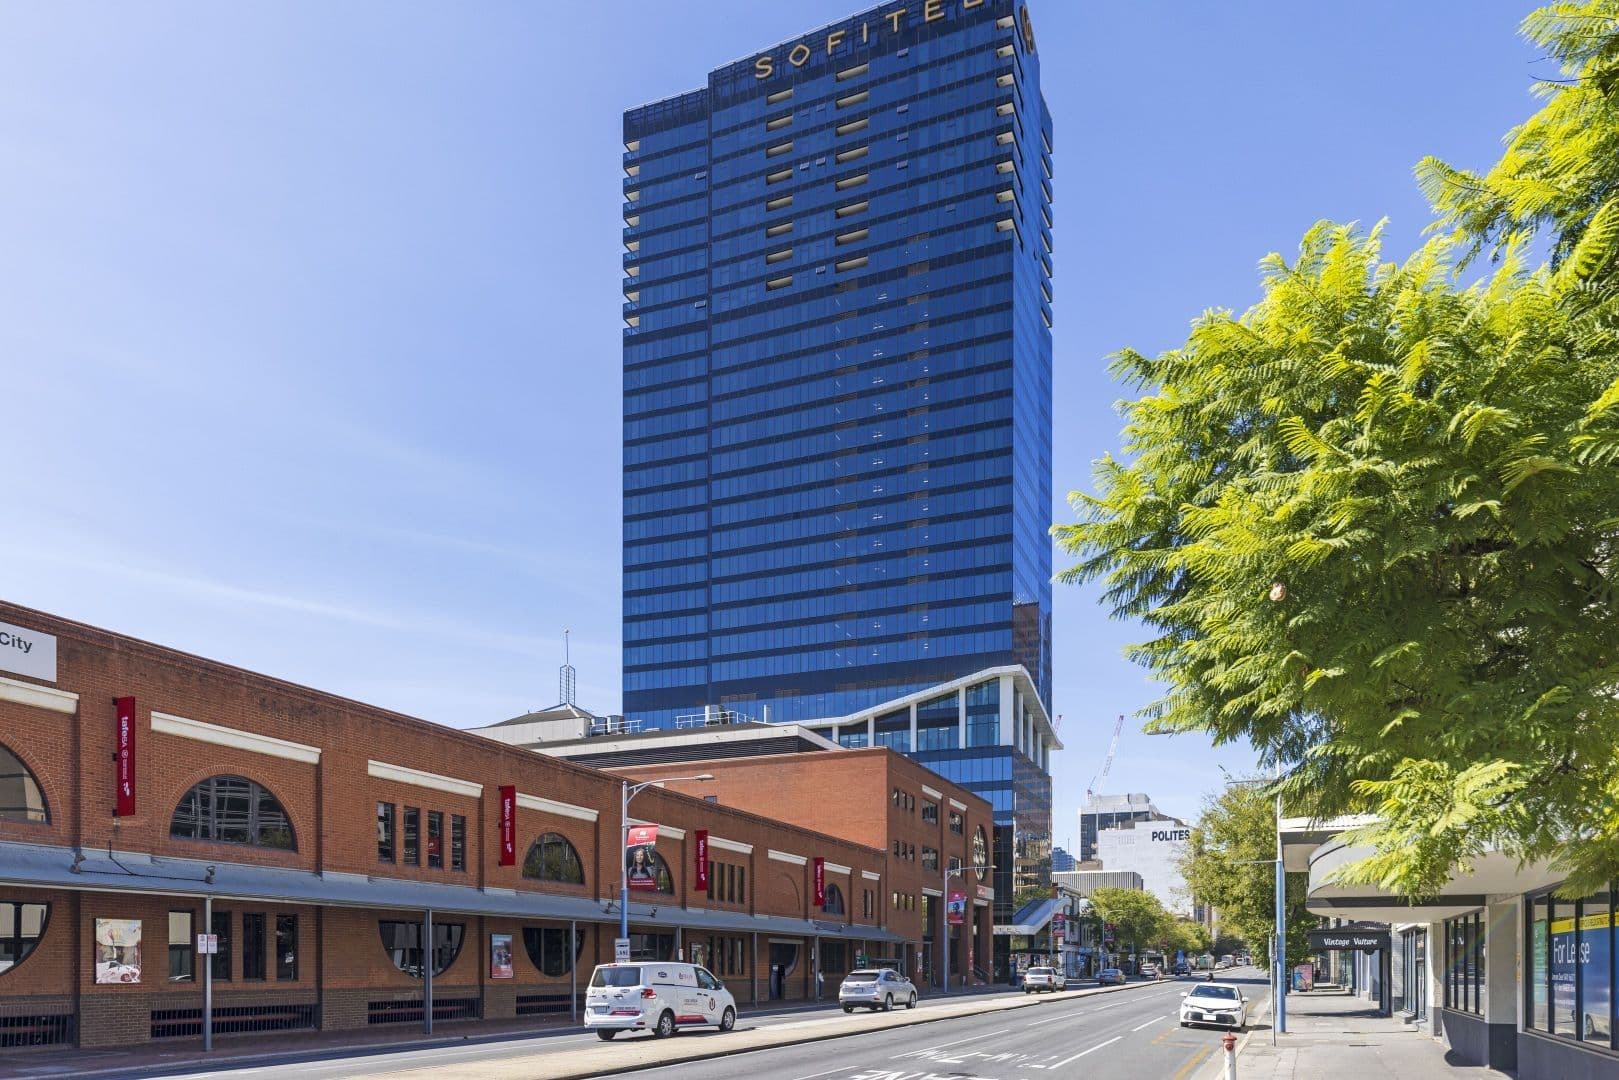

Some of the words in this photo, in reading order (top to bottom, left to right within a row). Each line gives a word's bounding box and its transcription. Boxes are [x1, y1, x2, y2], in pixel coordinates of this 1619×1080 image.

[0, 632, 33, 653] City
[1152, 830, 1190, 842] POLITES
[1323, 938, 1350, 947] Vintage
[1353, 937, 1378, 945] Vulture
[1553, 937, 1566, 964] For
[1566, 936, 1590, 964] Lese
